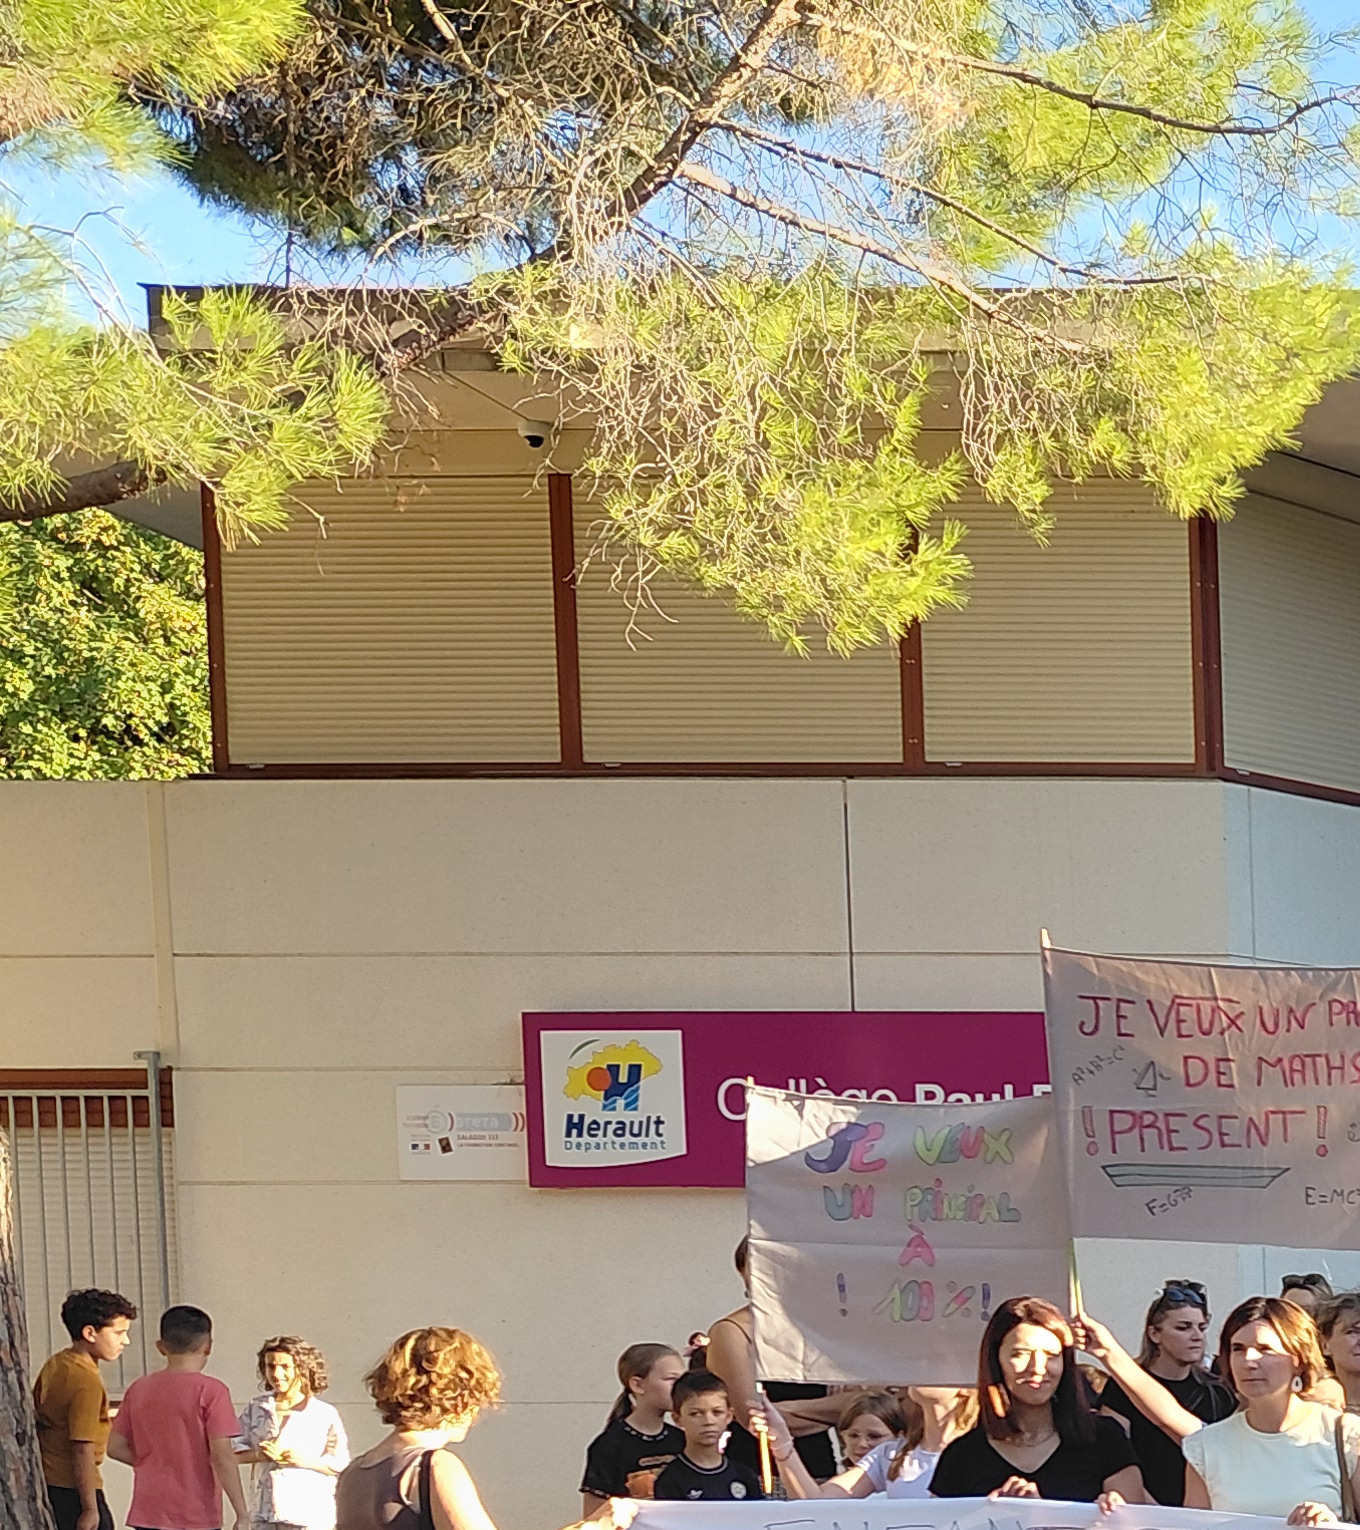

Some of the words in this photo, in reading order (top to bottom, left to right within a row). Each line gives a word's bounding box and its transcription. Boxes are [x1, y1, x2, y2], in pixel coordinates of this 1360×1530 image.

[1078, 995, 1135, 1037] JE
[1146, 995, 1246, 1038] VEUX
[1259, 1001, 1316, 1035] UN
[1183, 1055, 1235, 1088] DE
[805, 1121, 887, 1174] JE
[914, 1122, 1014, 1165] VEUX
[823, 1183, 875, 1221] UN
[899, 1223, 935, 1267] À
